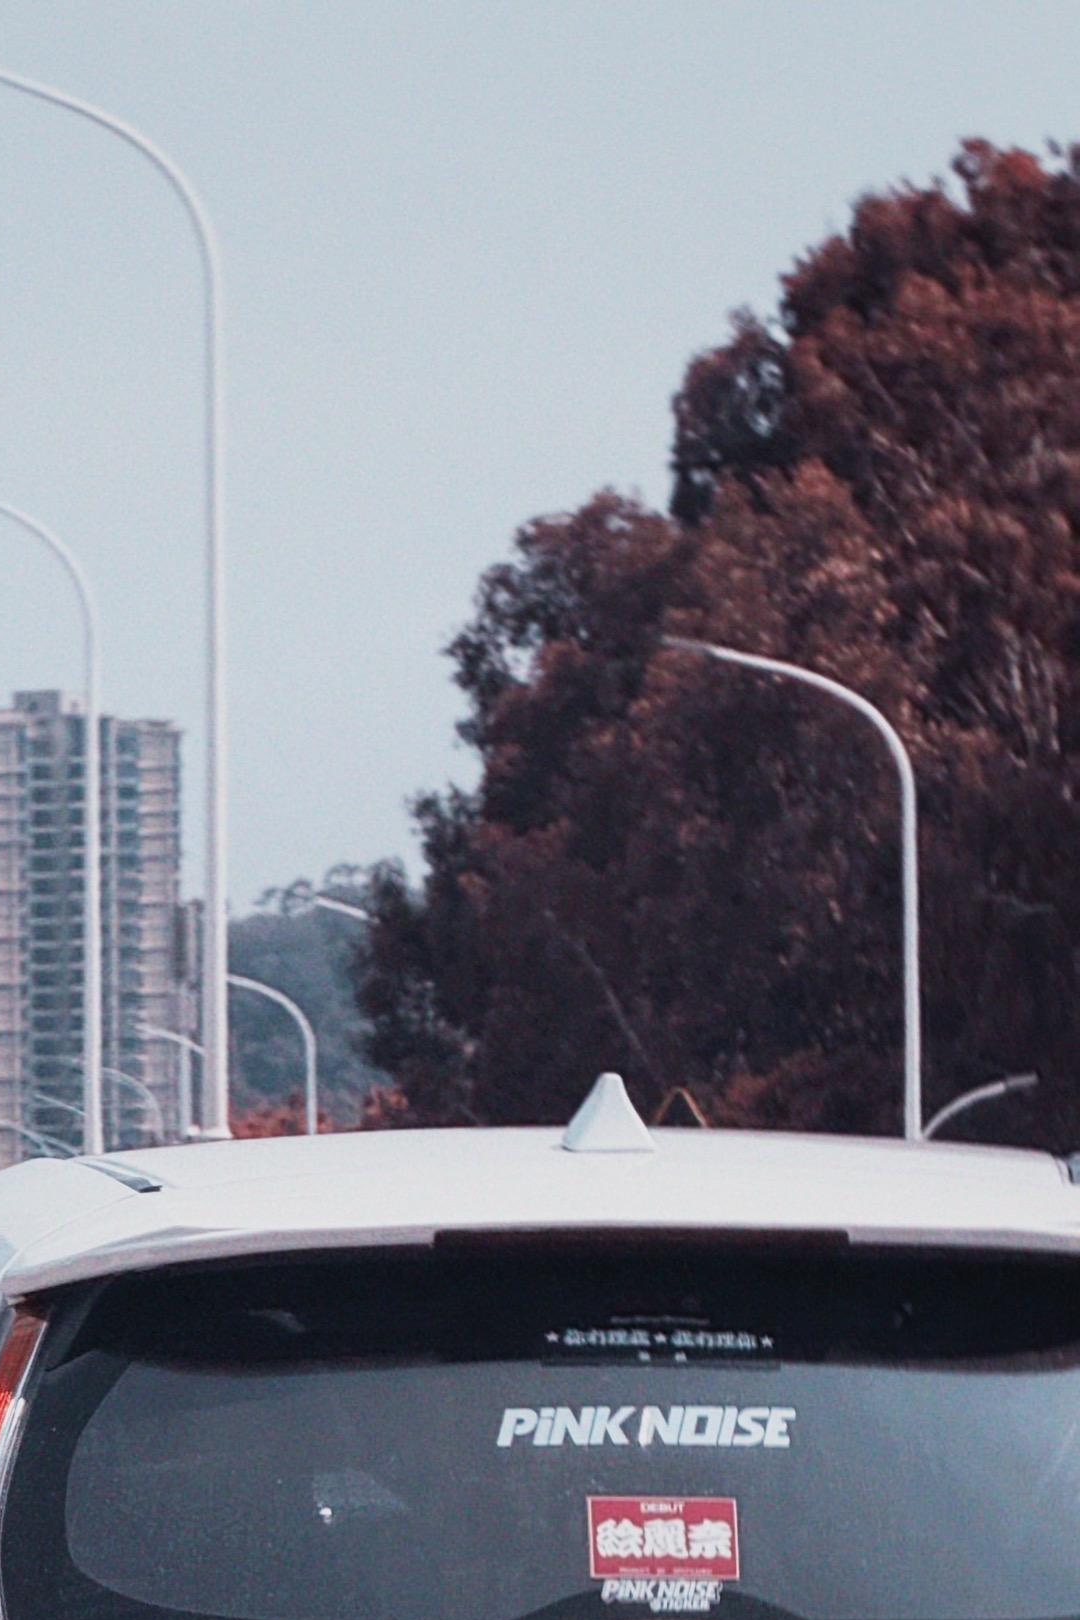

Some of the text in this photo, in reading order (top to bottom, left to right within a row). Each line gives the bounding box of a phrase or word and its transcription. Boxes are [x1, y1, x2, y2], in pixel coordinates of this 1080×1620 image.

[637, 1404, 797, 1448] NOISE
[640, 1502, 686, 1514] DEBUT
[657, 1579, 723, 1604] NOISE
